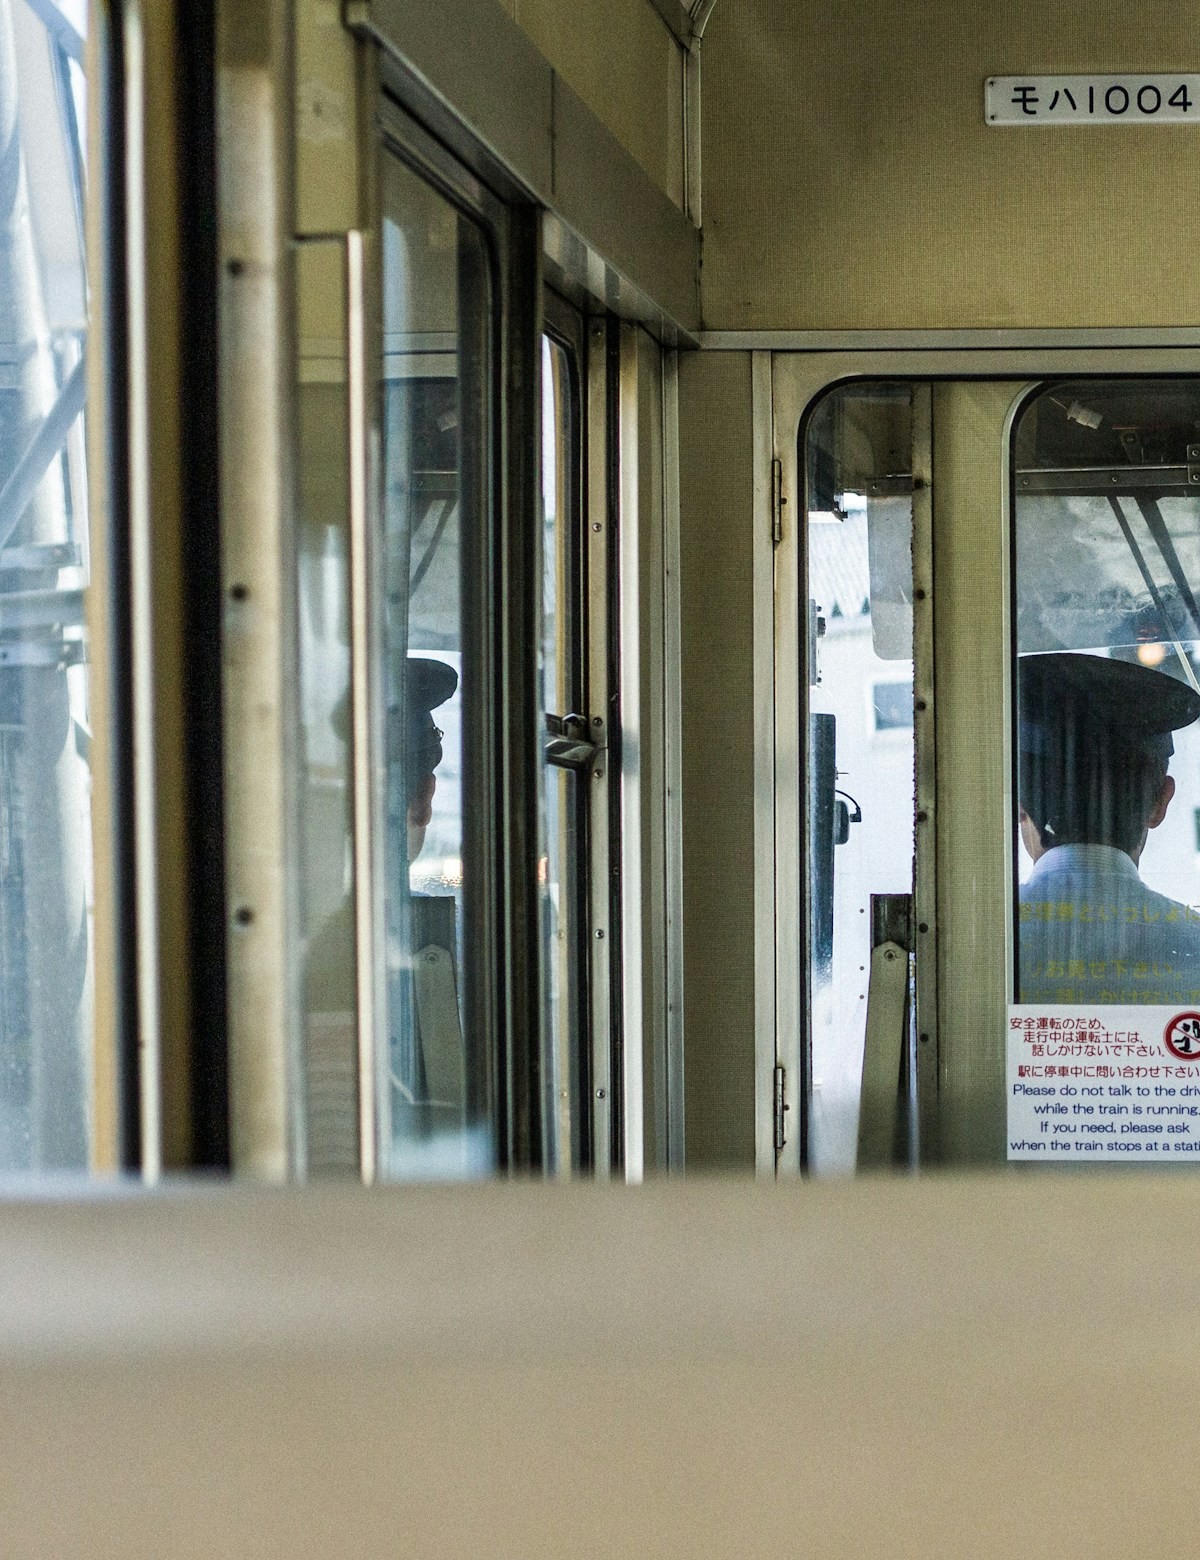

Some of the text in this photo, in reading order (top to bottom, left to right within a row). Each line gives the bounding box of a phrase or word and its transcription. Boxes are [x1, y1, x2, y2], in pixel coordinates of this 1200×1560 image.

[1010, 1017, 1106, 1030] 安全運転のため、
[1023, 1031, 1144, 1044] 走行中は運転士には、
[1032, 1044, 1165, 1058] 話しかけないで下さい。
[1013, 1084, 1055, 1096] Please
[1060, 1084, 1077, 1096] do
[1081, 1085, 1103, 1096] not
[1108, 1084, 1131, 1096] talk
[1137, 1085, 1150, 1096] to
[1155, 1084, 1176, 1097] the
[1034, 1103, 1200, 1116] while the train is running.
[1040, 1121, 1049, 1133] If
[1052, 1123, 1076, 1134] you
[1121, 1122, 1163, 1134] please
[1167, 1122, 1190, 1134] ask
[1010, 1140, 1046, 1151] when
[1050, 1140, 1071, 1151] the
[1075, 1140, 1103, 1151] train
[1107, 1142, 1141, 1152] stops
[1145, 1142, 1159, 1152] at
[1162, 1143, 1170, 1152] a
